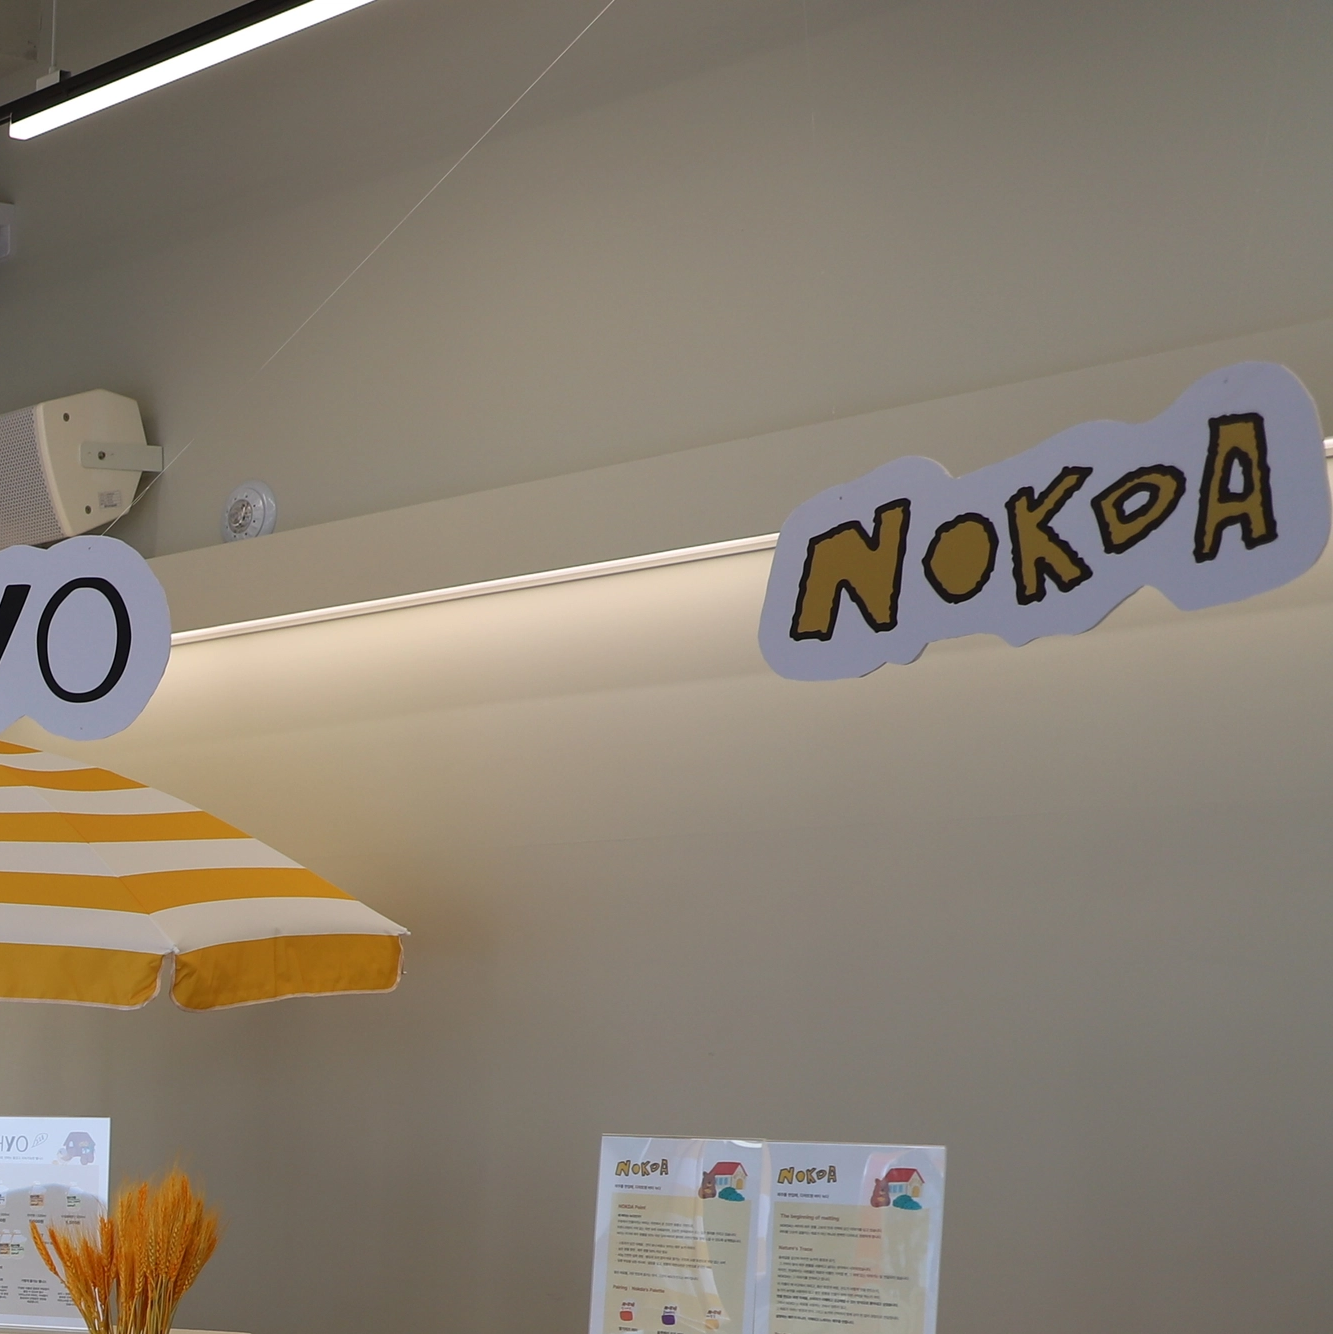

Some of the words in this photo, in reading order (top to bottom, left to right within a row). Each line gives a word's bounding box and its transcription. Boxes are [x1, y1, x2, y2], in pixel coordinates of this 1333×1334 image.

[789, 412, 1278, 641] NOKDA
[615, 1158, 669, 1177] NOKDA
[777, 1165, 837, 1184] NOKDA
